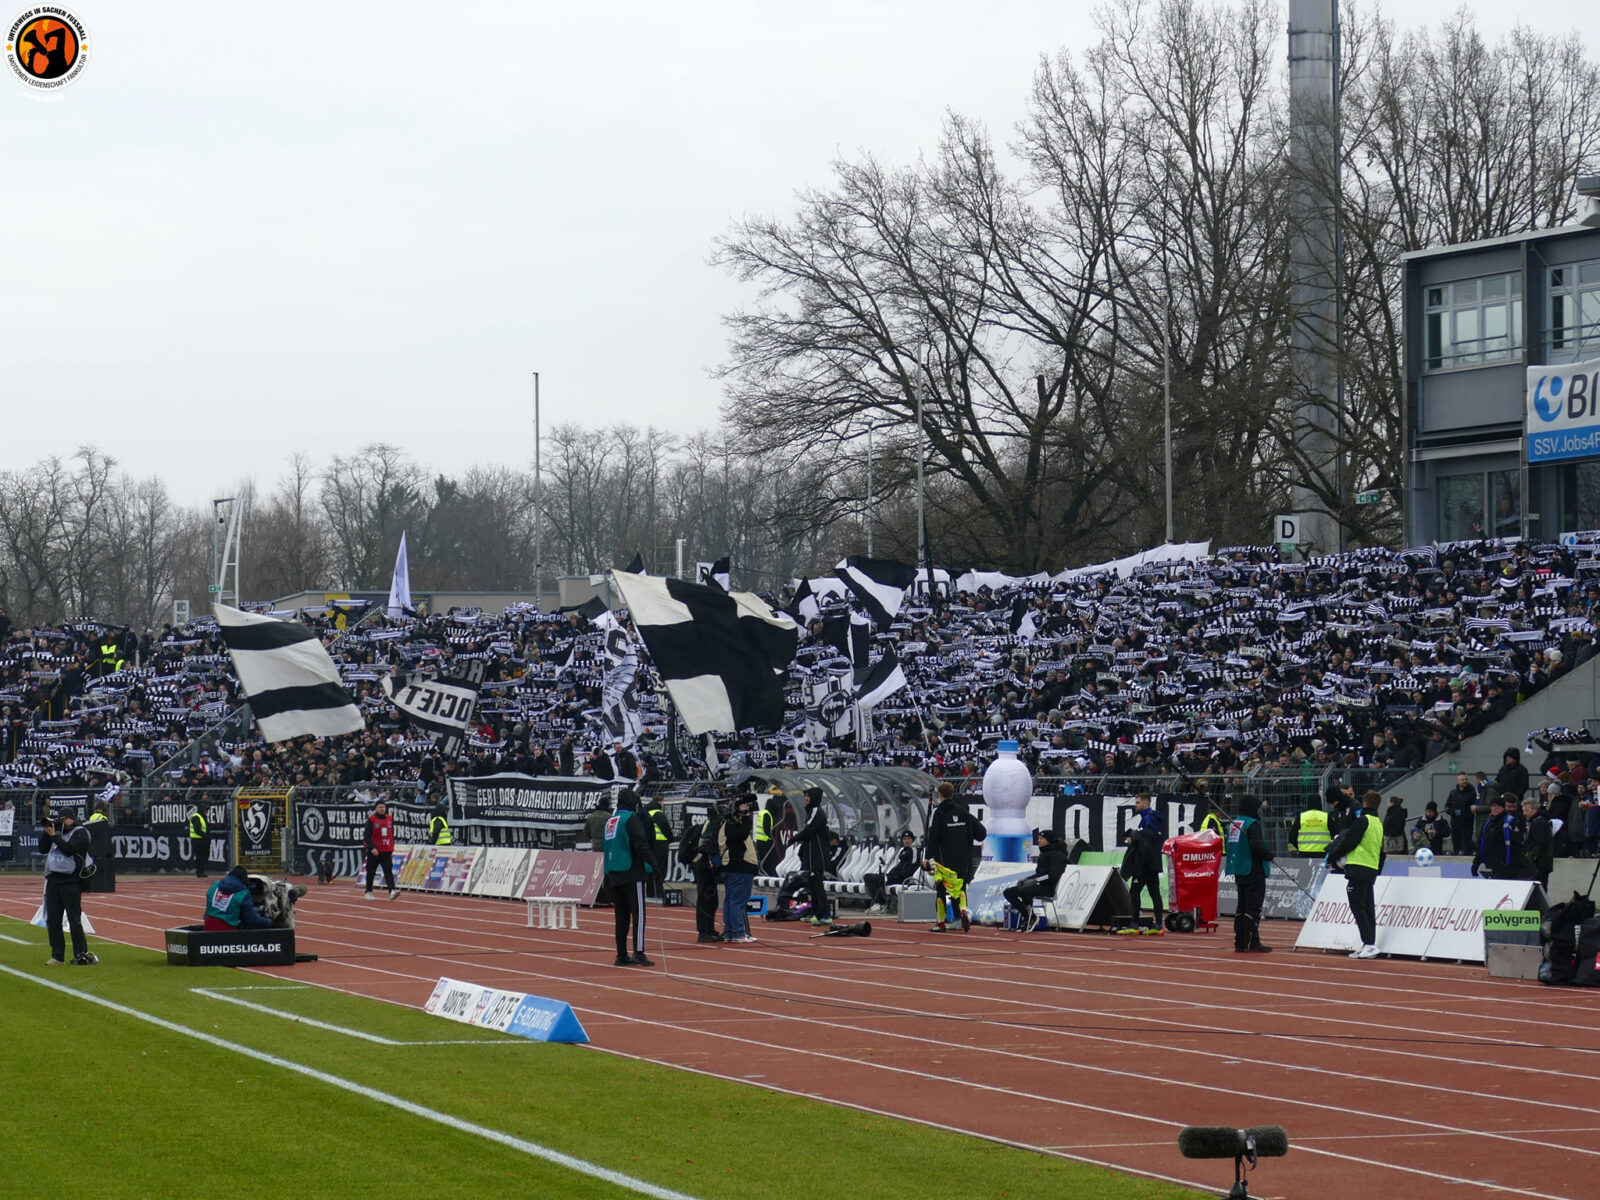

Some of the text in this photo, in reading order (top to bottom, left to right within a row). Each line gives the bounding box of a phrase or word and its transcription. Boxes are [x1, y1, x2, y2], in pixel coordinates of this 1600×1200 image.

[1282, 520, 1295, 539] D
[476, 787, 497, 806] GEBT
[499, 787, 516, 806] DAS
[517, 789, 582, 811] DONAUSTADION
[151, 804, 186, 824] DONAU
[327, 810, 347, 824] WIR
[409, 812, 432, 825] ZUSA
[329, 826, 351, 840] UND
[177, 837, 226, 862] UM
[382, 839, 391, 847] TV
[1191, 852, 1216, 861] MUNK
[1376, 903, 1428, 930] ZENTRUM
[1428, 906, 1484, 933] NEU-ULM
[1484, 913, 1540, 927] polygran
[200, 943, 281, 954] BUNDESLIGA.DE
